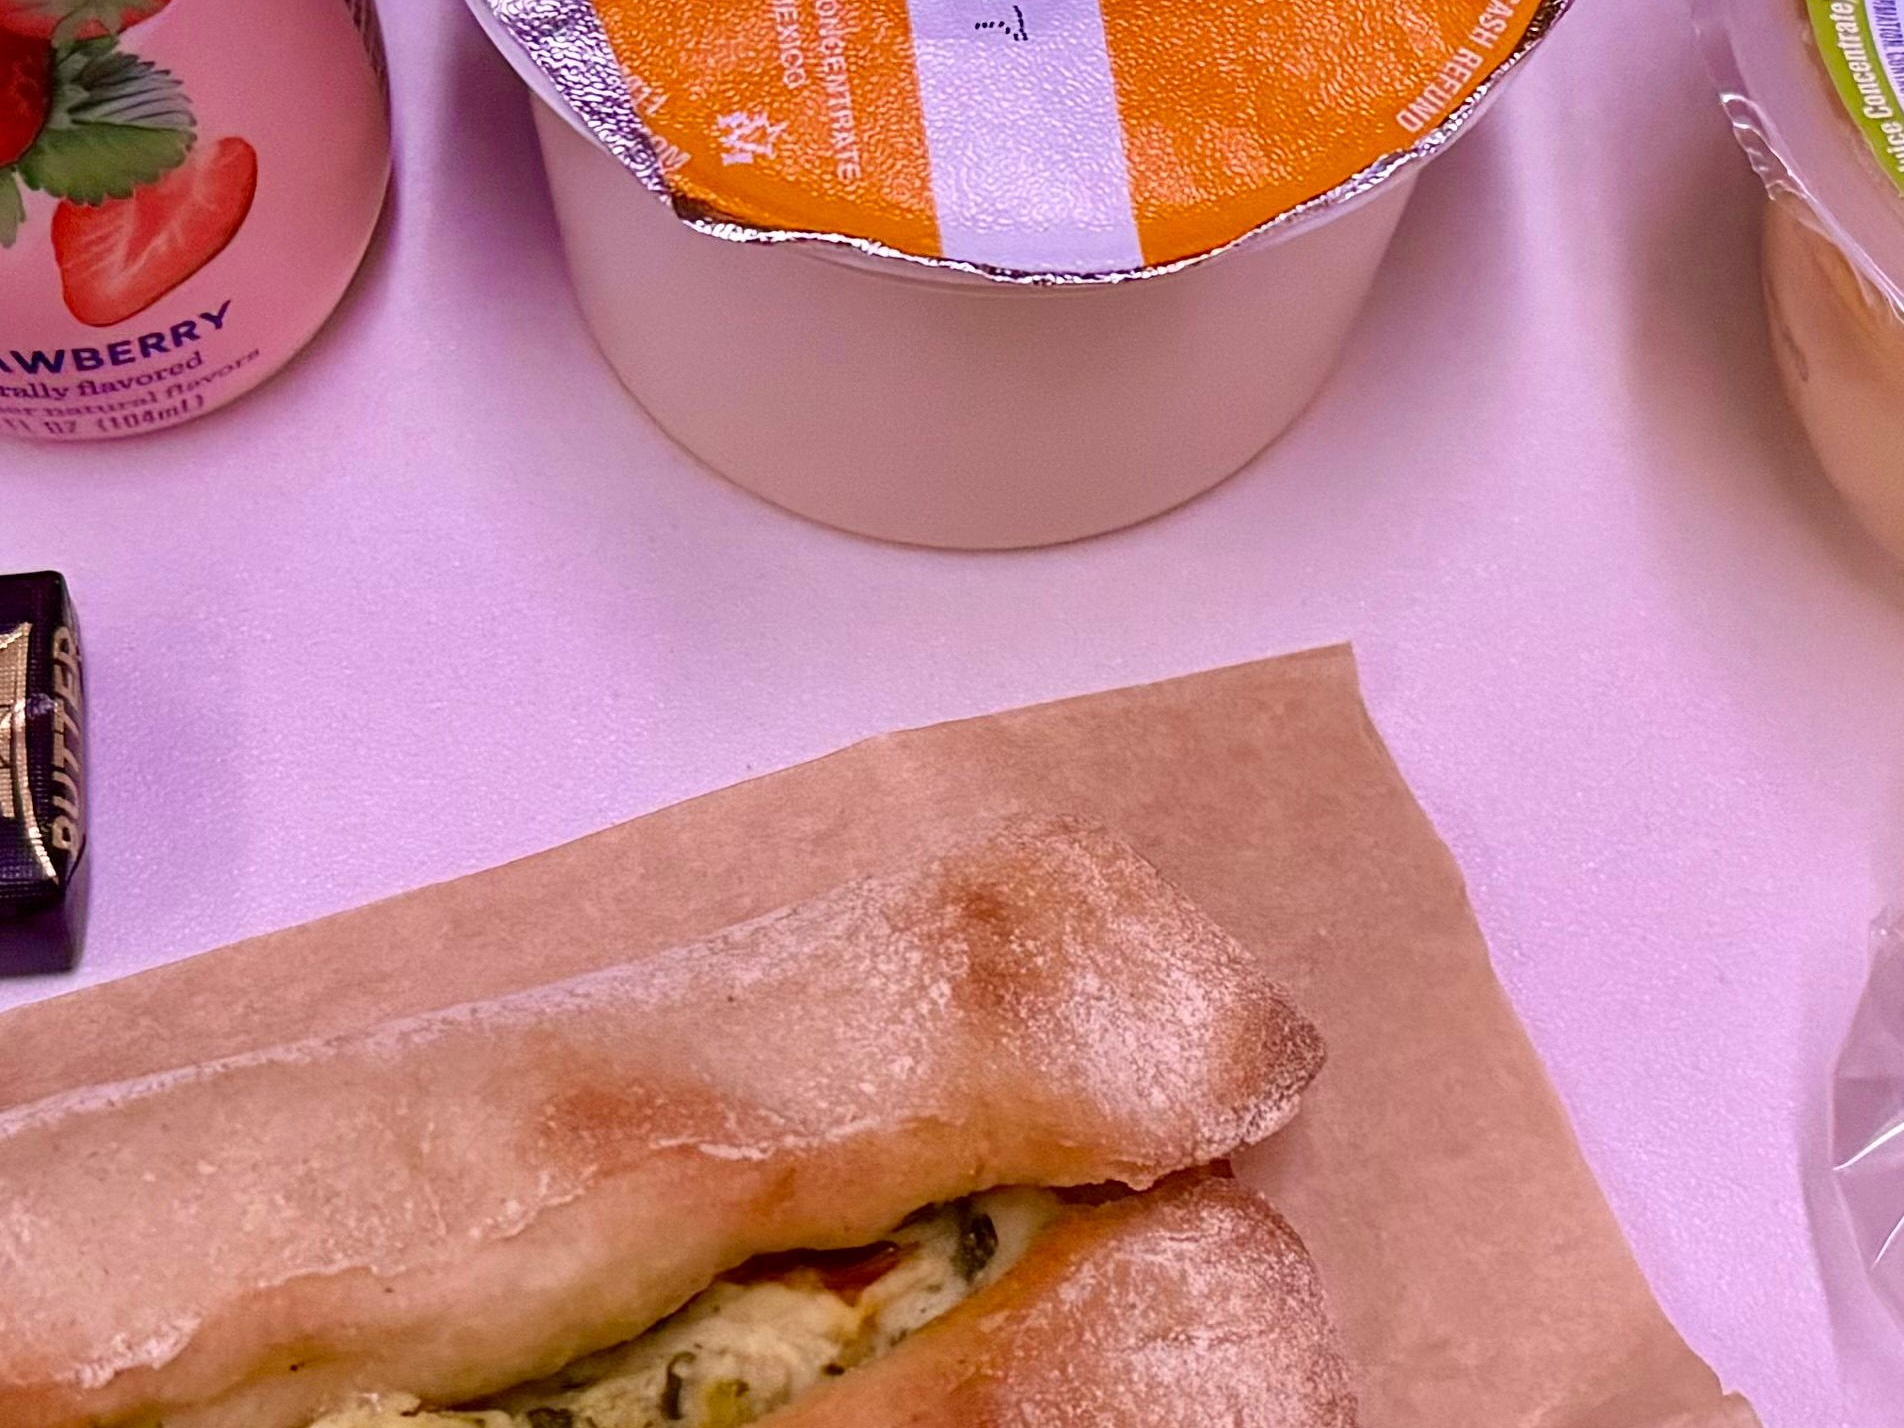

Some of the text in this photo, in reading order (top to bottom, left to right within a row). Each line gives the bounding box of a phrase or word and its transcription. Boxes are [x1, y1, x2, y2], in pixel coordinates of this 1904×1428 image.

[1395, 47, 1482, 132] REFUND
[76, 349, 204, 400] flavored
[42, 390, 158, 419] natural
